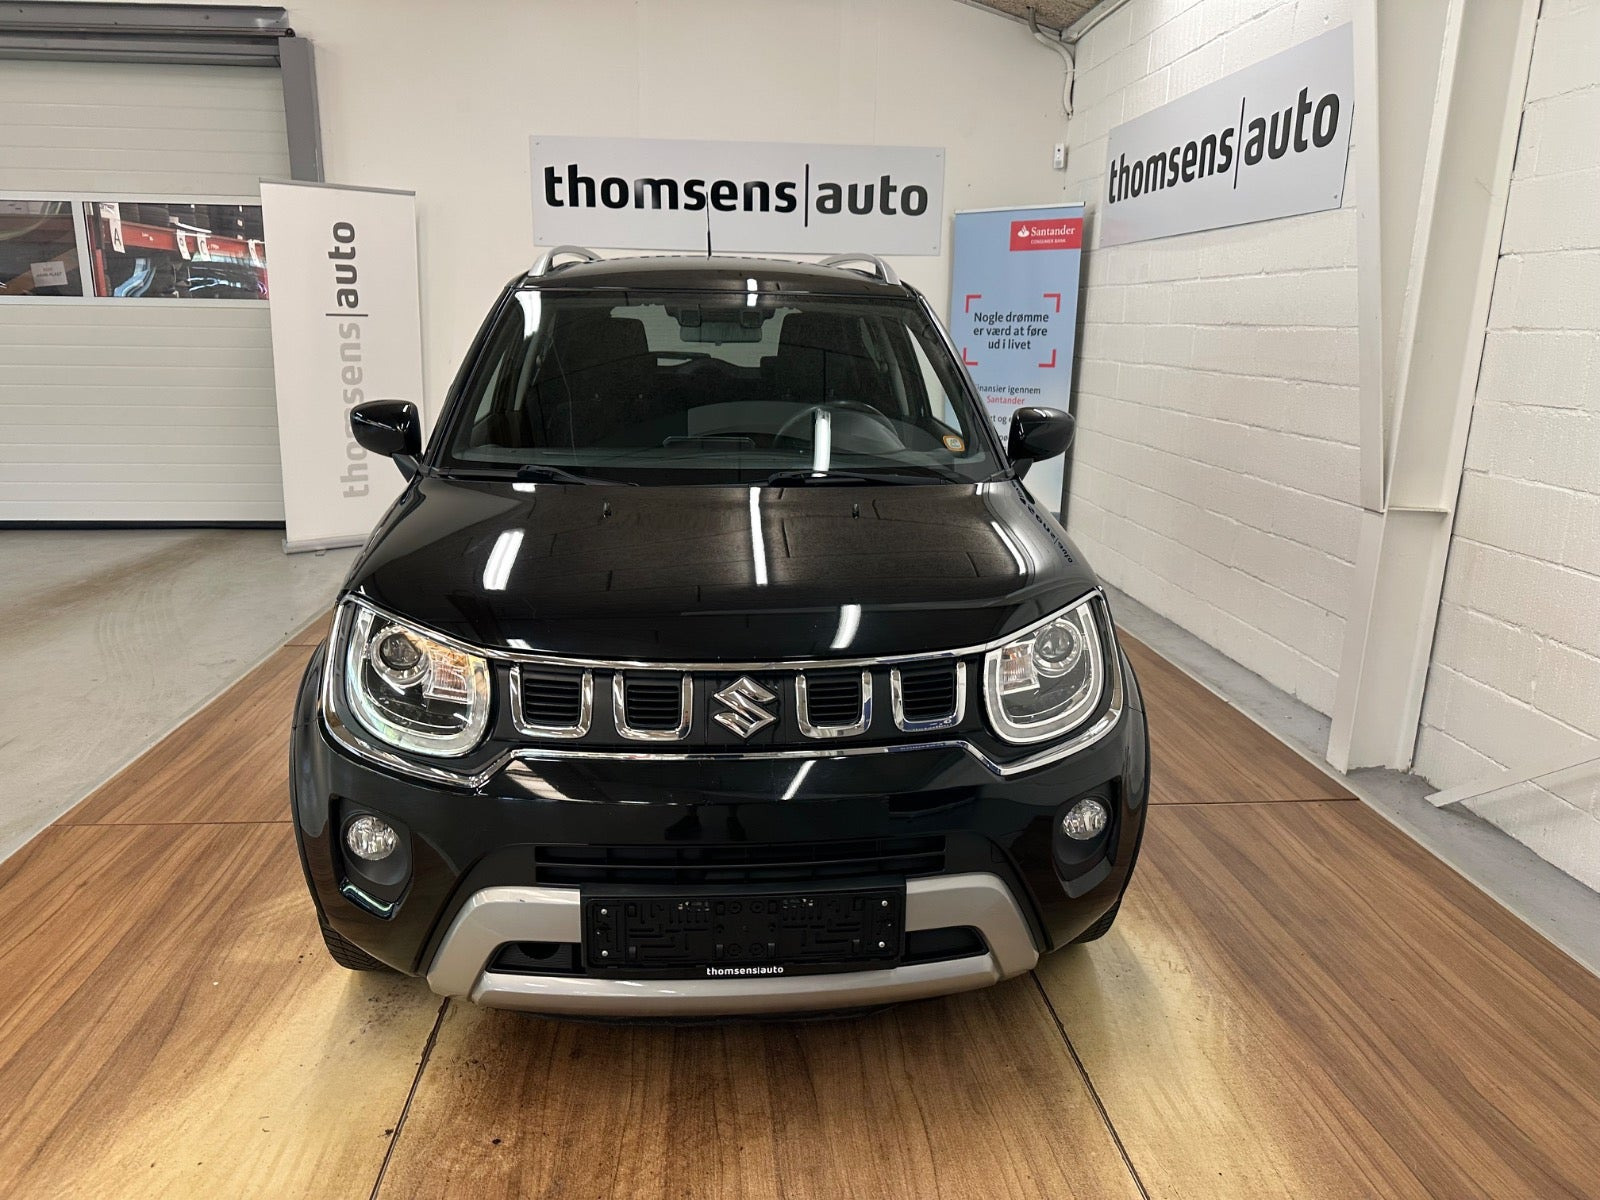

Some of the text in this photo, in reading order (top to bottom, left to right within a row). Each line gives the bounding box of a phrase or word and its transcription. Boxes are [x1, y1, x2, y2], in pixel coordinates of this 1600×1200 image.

[1030, 224, 1076, 236] Santander
[114, 228, 122, 246] A
[974, 311, 1049, 325] Nogle drømme
[973, 325, 1048, 336] er værd at føre
[988, 339, 1031, 350] ud i livet
[976, 384, 1041, 395] inansier igennem
[986, 395, 1025, 405] Santander
[997, 417, 1007, 425] og
